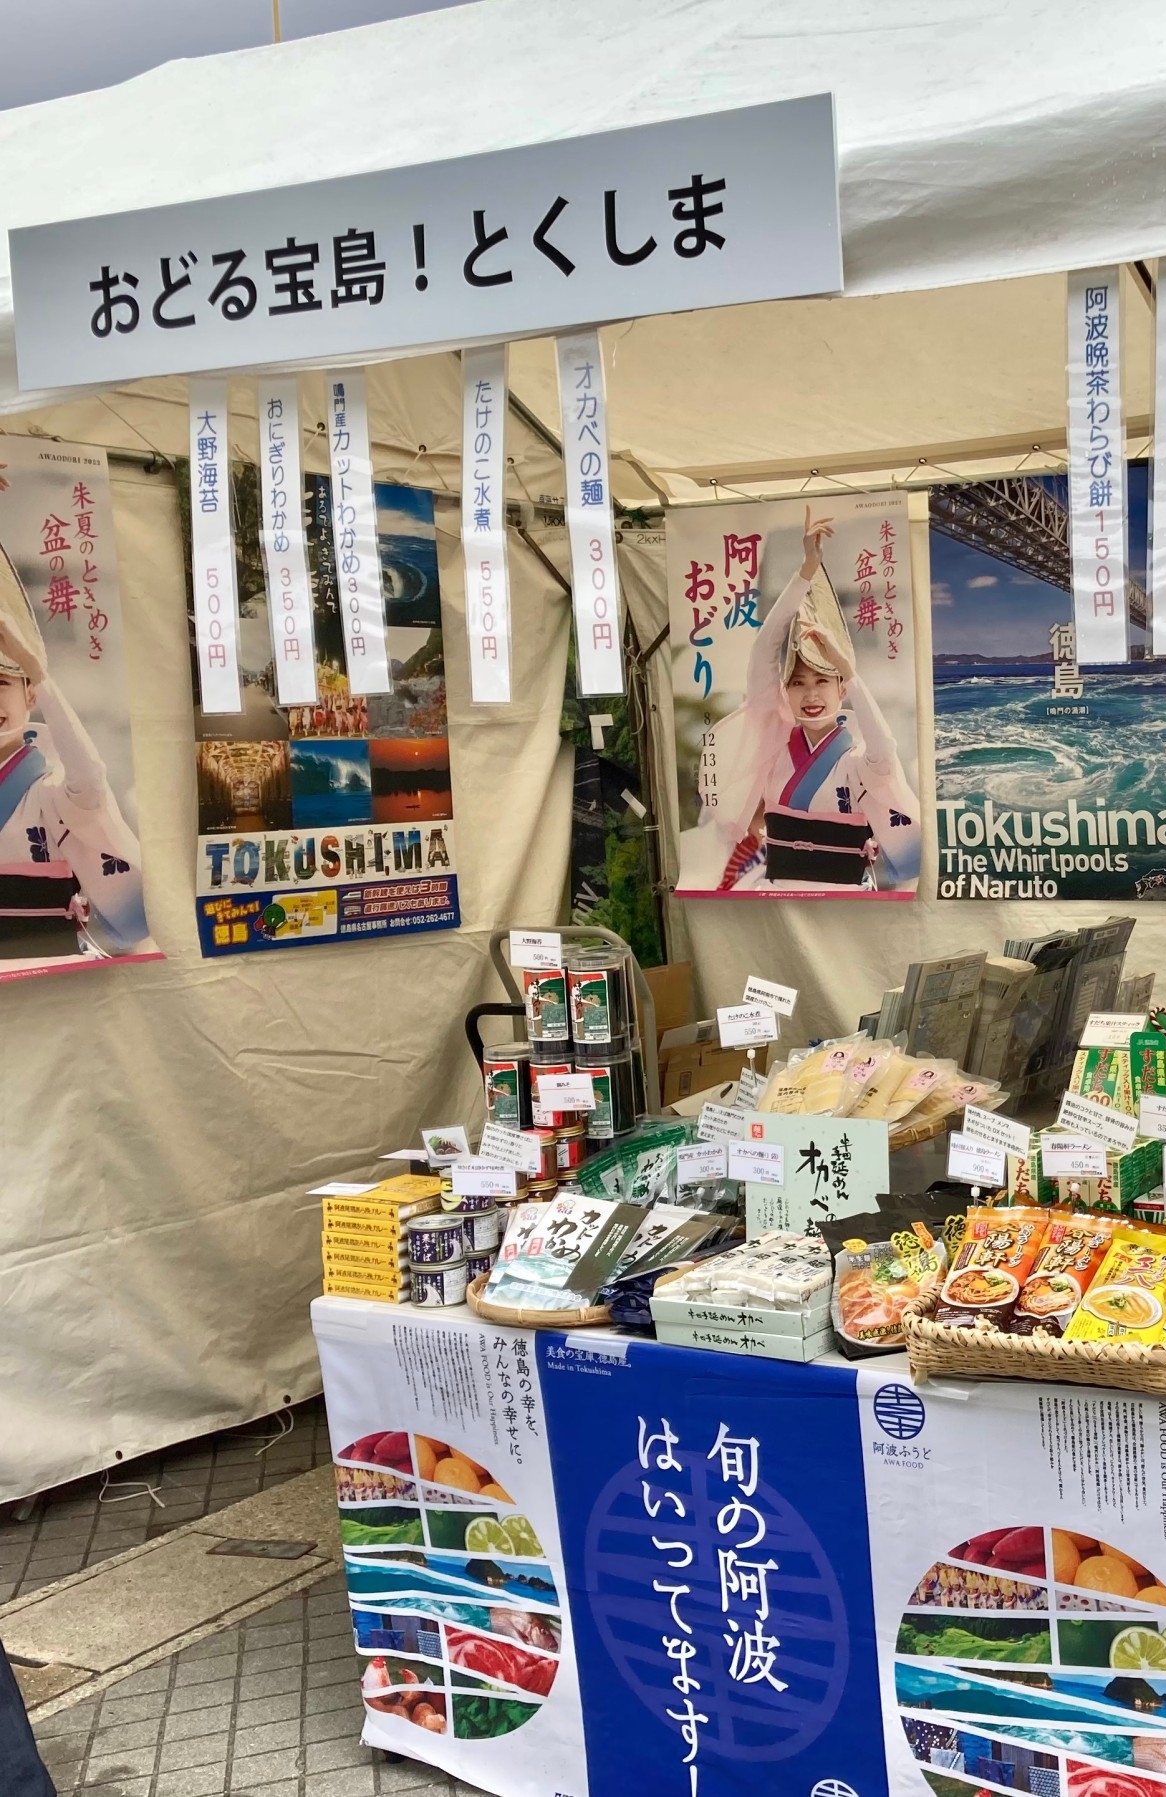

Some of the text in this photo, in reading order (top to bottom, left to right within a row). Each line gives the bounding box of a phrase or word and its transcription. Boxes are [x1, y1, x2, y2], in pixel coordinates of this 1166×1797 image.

[89, 173, 729, 339] おどる宝島！とくしま
[38, 453, 81, 464] AWAODORI
[1085, 286, 1114, 617] 阿波晩茶わらび餅 150円
[196, 412, 226, 668] 大野海苔 500円
[267, 398, 300, 661] おにぎりわかめ 350円
[332, 382, 366, 657] 鳴門産カットわかめ 300円
[474, 380, 498, 660] たけのこ水煮 550円
[574, 362, 613, 651] オカベの麺 300円
[40, 514, 80, 622] 盆の舞
[71, 482, 108, 660] 朱夏のときめき
[723, 533, 764, 629] 阿波
[853, 548, 880, 633] 盆の舞
[879, 520, 904, 660] 朱夏のときめき
[685, 560, 718, 700] おどり
[1049, 622, 1084, 700] 徳島
[701, 733, 715, 747] 12
[702, 753, 716, 767] 13
[704, 712, 711, 725] 8
[703, 773, 717, 787] 14
[704, 794, 718, 807] 15
[206, 829, 450, 888] TOKUSHIMA
[940, 875, 1058, 899] of Naruto
[941, 848, 1129, 878] The Whirlpools
[481, 1354, 492, 1381] FOOD
[493, 1336, 523, 1465] みんなの幸せに。
[511, 1338, 539, 1437] 徳島の幸を、
[545, 1345, 632, 1369] 美食の宝庫、徳島産。
[547, 1361, 613, 1377] Made in Tokushima
[883, 1458, 925, 1470] AWA FOOD
[707, 1421, 789, 1694] 旬の阿波
